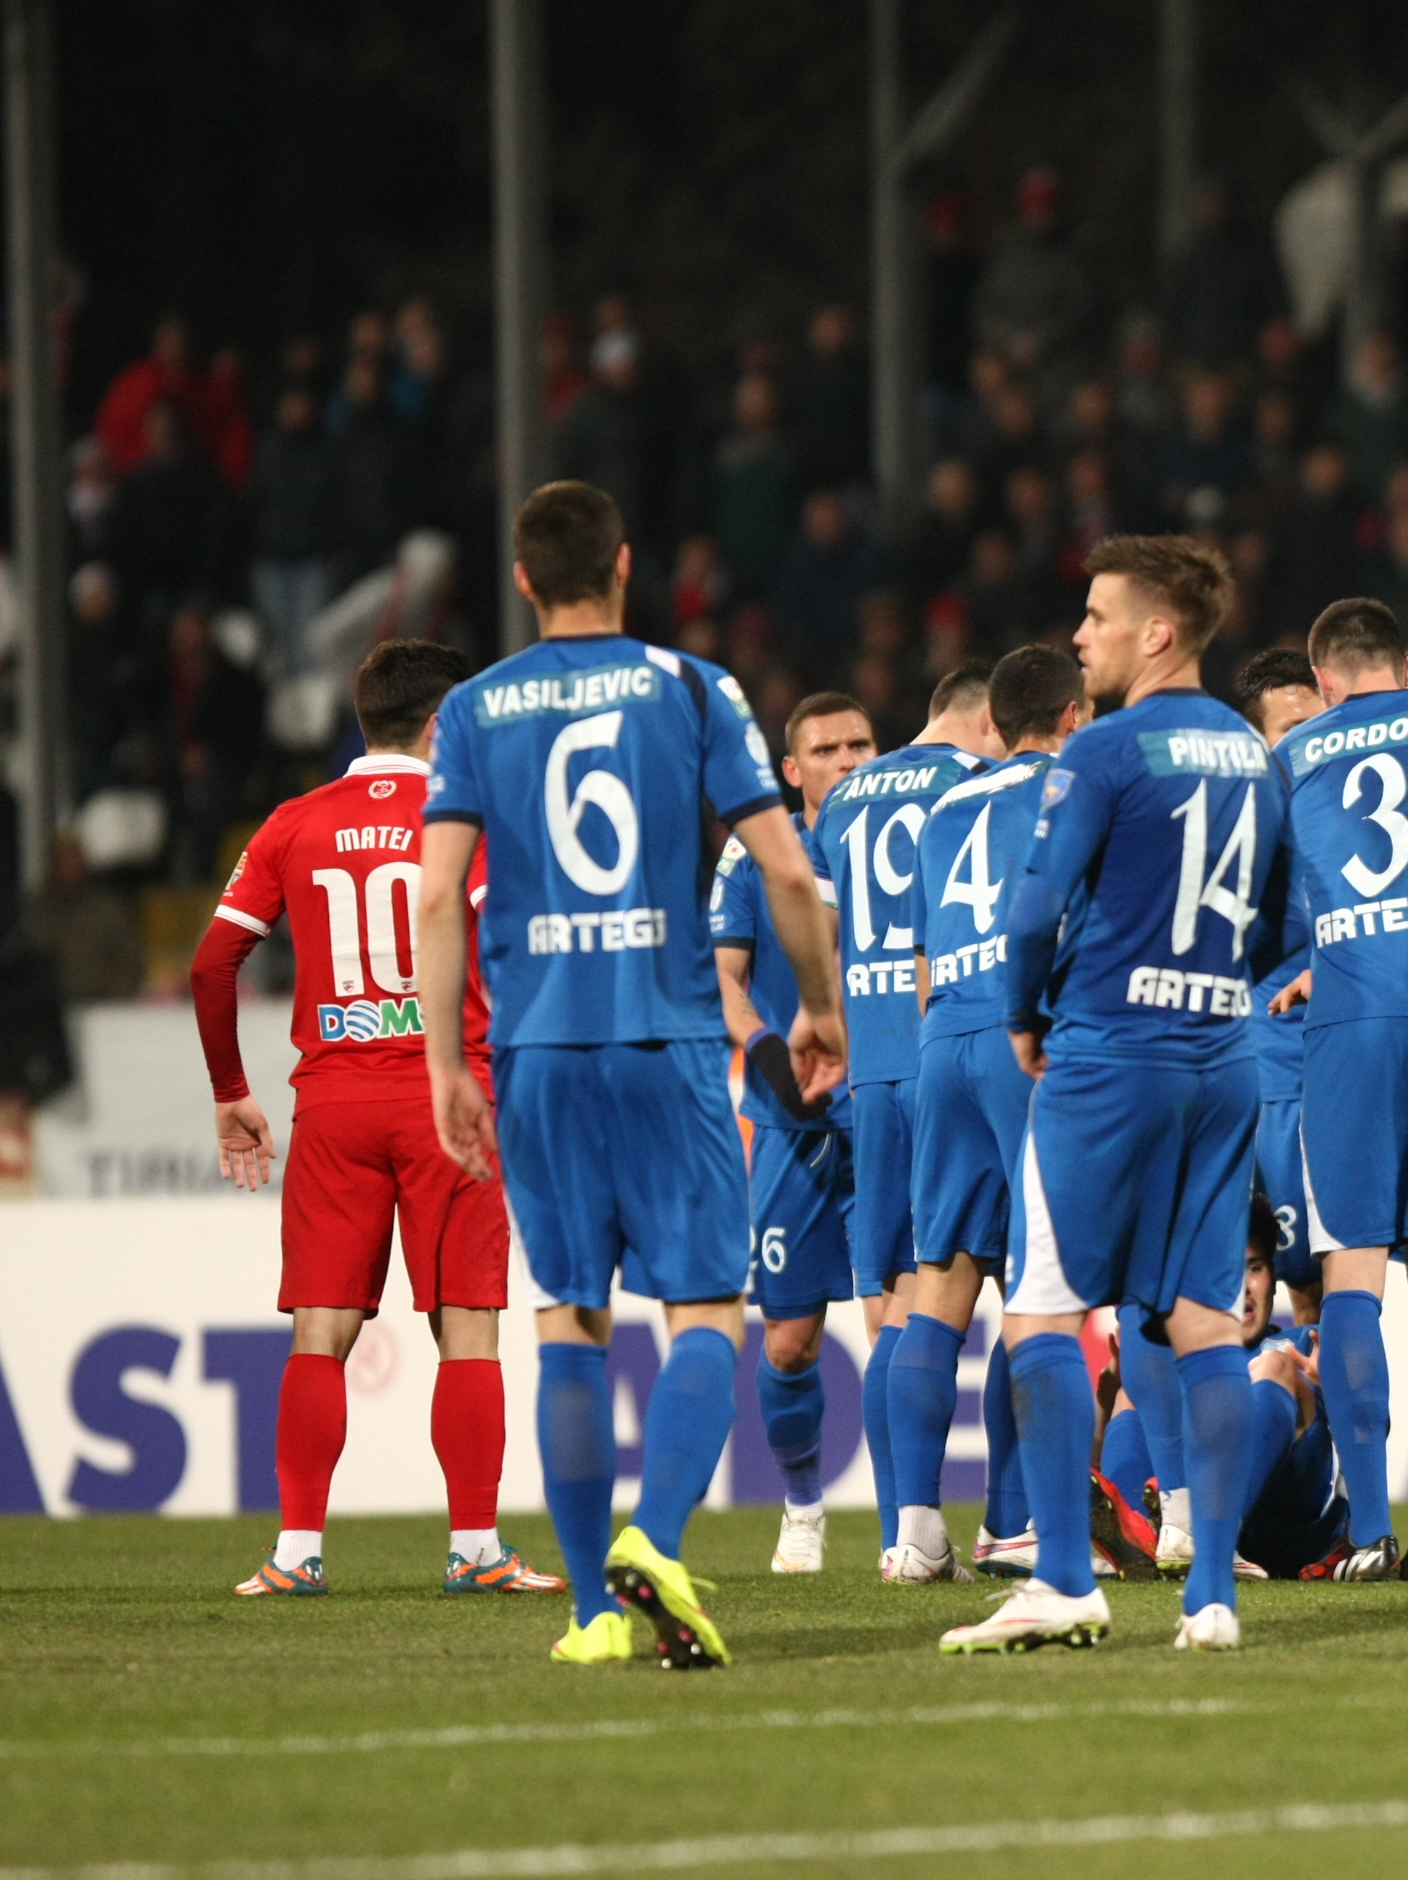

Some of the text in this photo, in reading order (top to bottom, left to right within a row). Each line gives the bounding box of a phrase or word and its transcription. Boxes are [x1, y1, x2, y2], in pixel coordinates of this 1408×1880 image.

[483, 666, 654, 718] VASILJEVIC
[335, 826, 414, 852] MATEI
[545, 710, 640, 897] 6
[940, 800, 1005, 935] 4
[1171, 778, 1260, 964] 14
[312, 861, 424, 998] 10
[317, 997, 426, 1042] DOM
